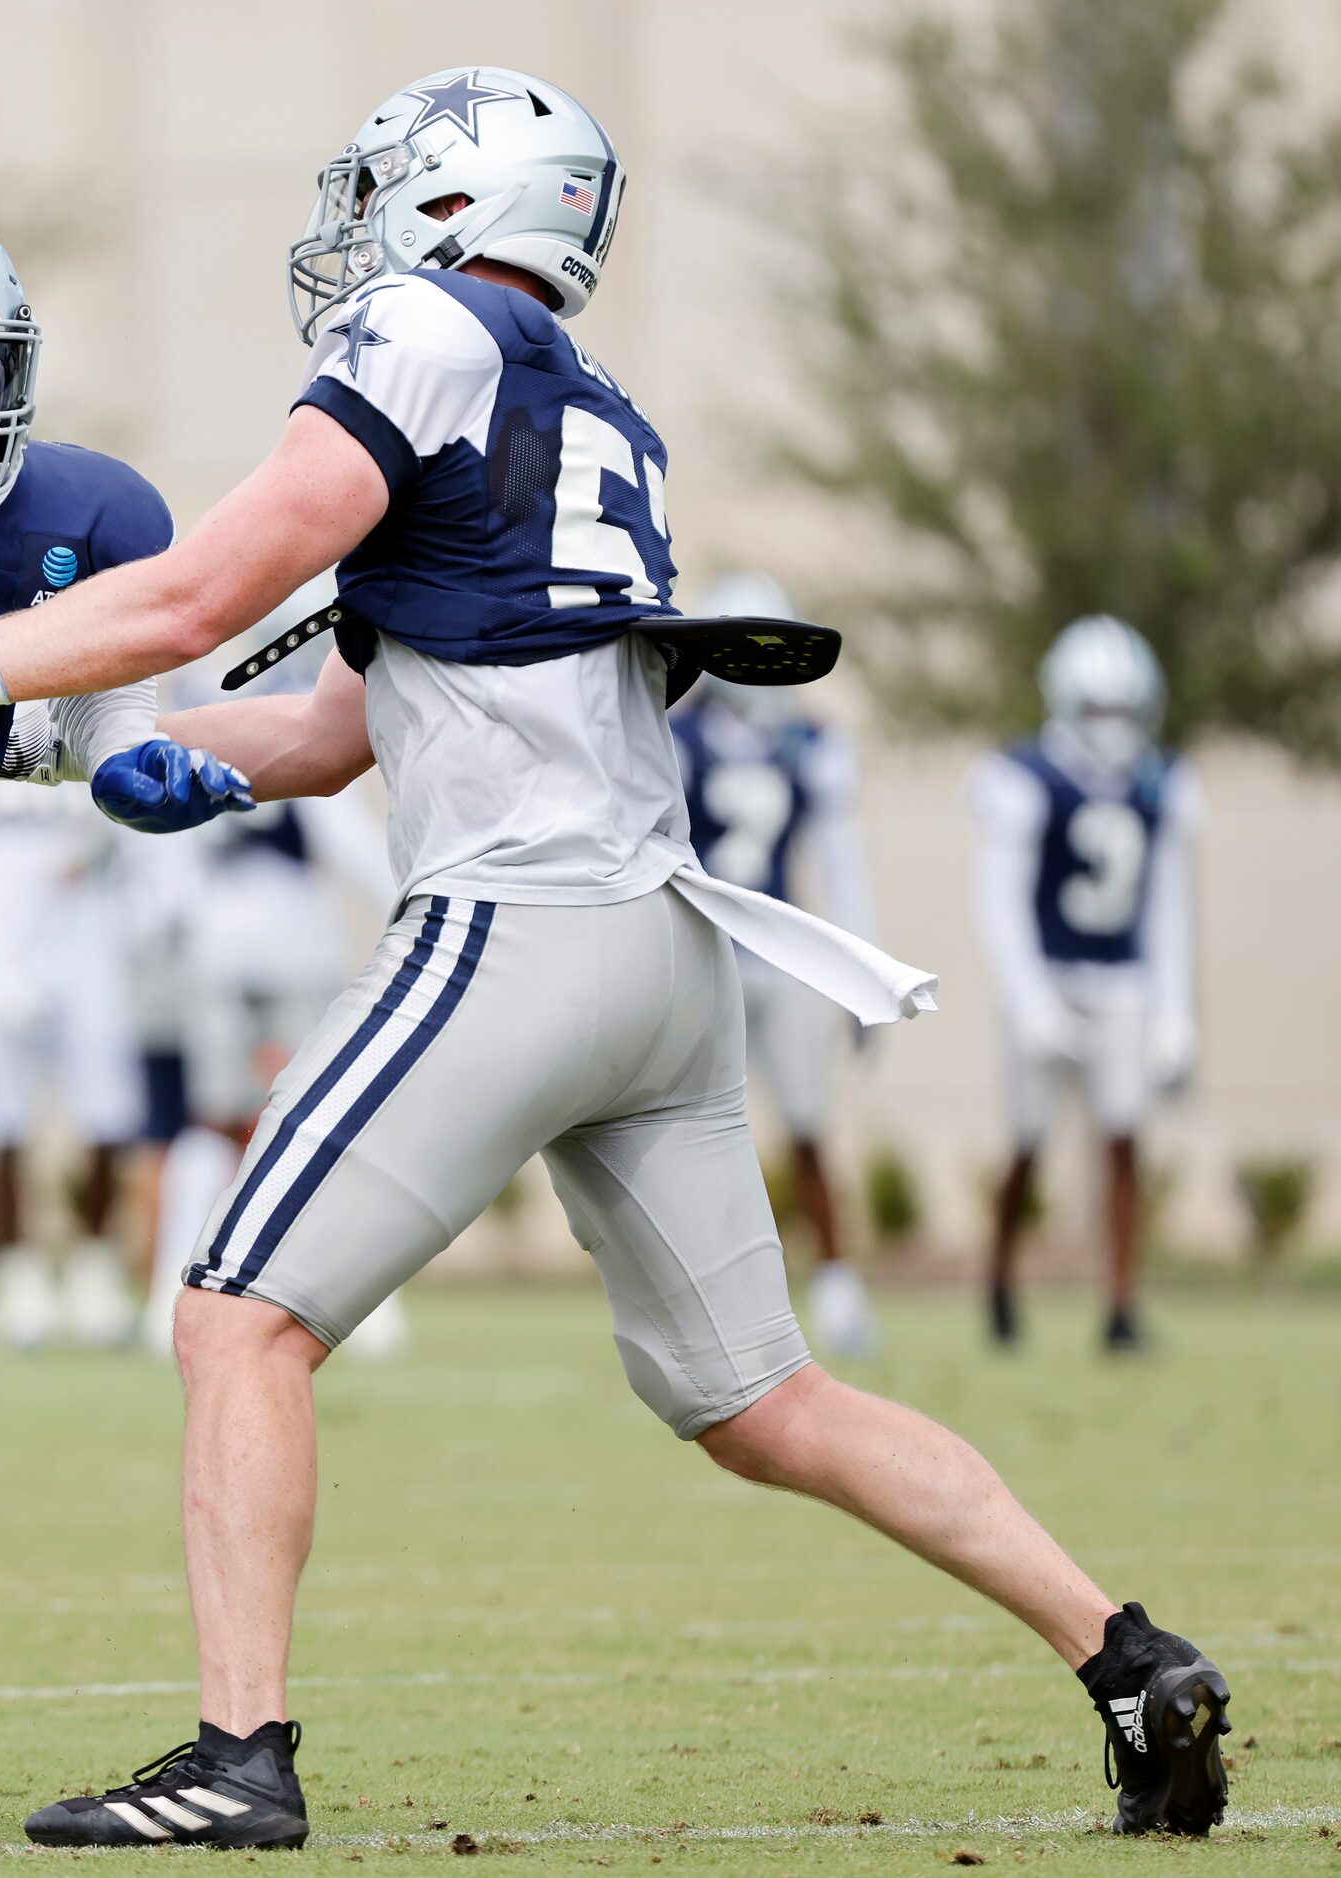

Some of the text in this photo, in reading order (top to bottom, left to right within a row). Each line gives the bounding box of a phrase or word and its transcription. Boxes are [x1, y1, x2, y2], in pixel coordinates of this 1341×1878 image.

[31, 590, 59, 607] AT
[1058, 800, 1147, 935] 3
[1132, 1689, 1148, 1753] adidas
